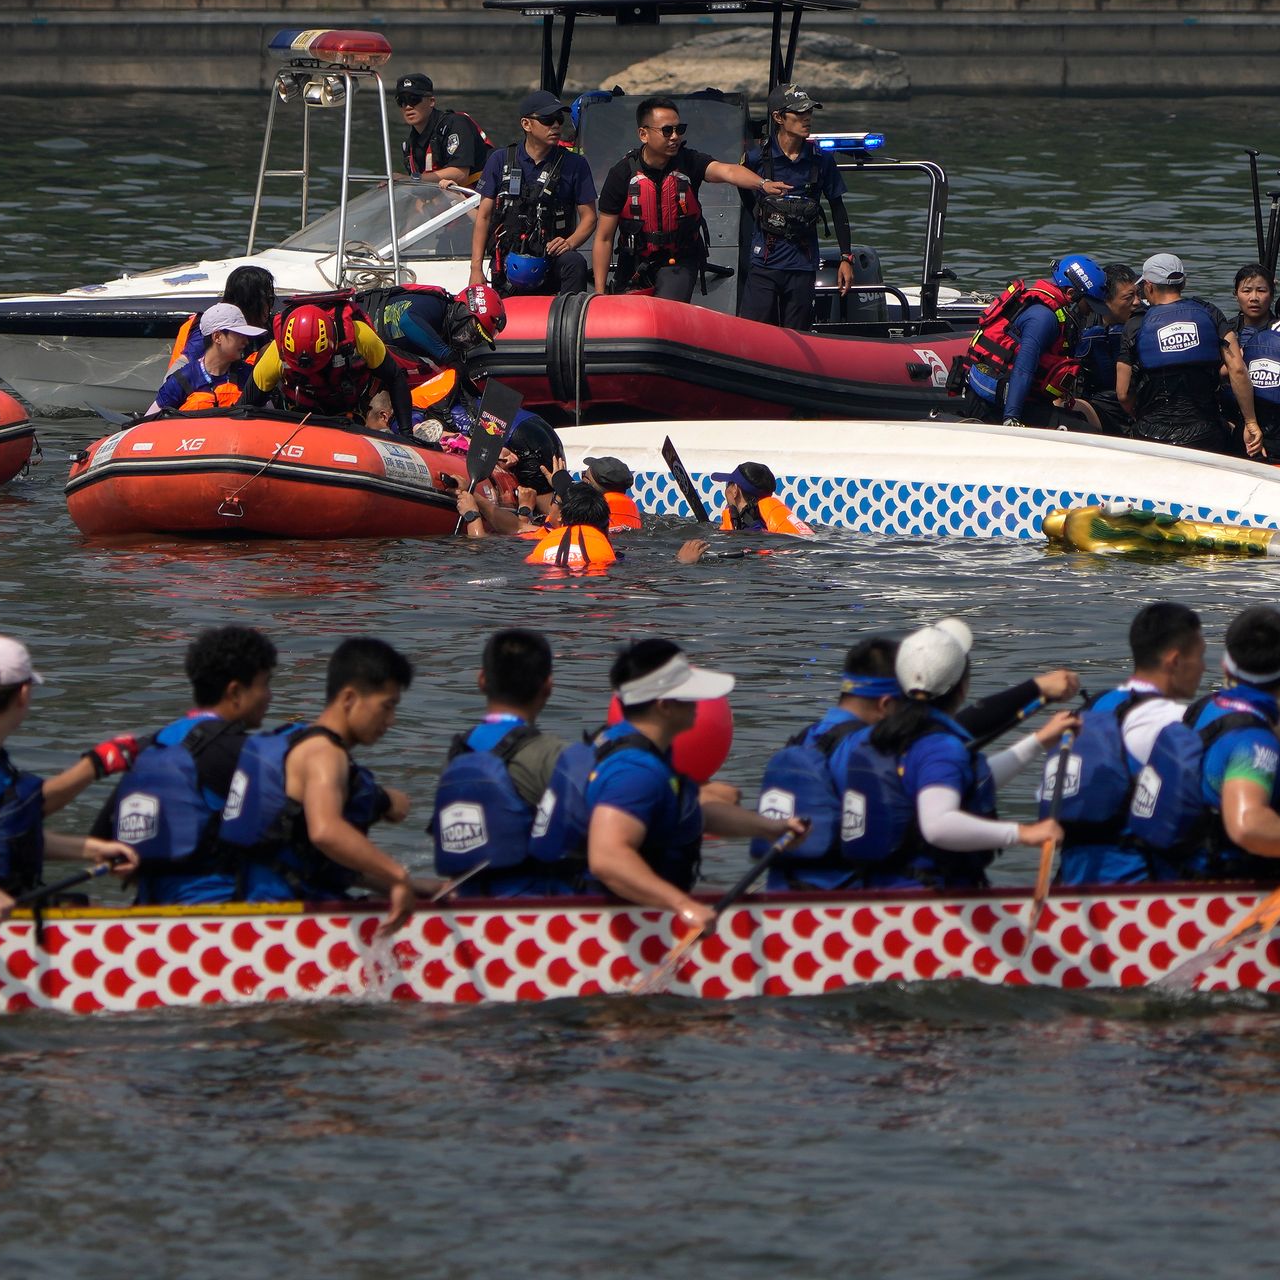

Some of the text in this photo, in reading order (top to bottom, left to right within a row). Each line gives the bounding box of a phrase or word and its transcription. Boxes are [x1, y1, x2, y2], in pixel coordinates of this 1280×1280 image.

[1161, 333, 1196, 346] TODAY
[1250, 371, 1280, 381] TODAY
[176, 438, 206, 451] XG
[272, 443, 304, 457] XG
[443, 825, 481, 841] TODAY
